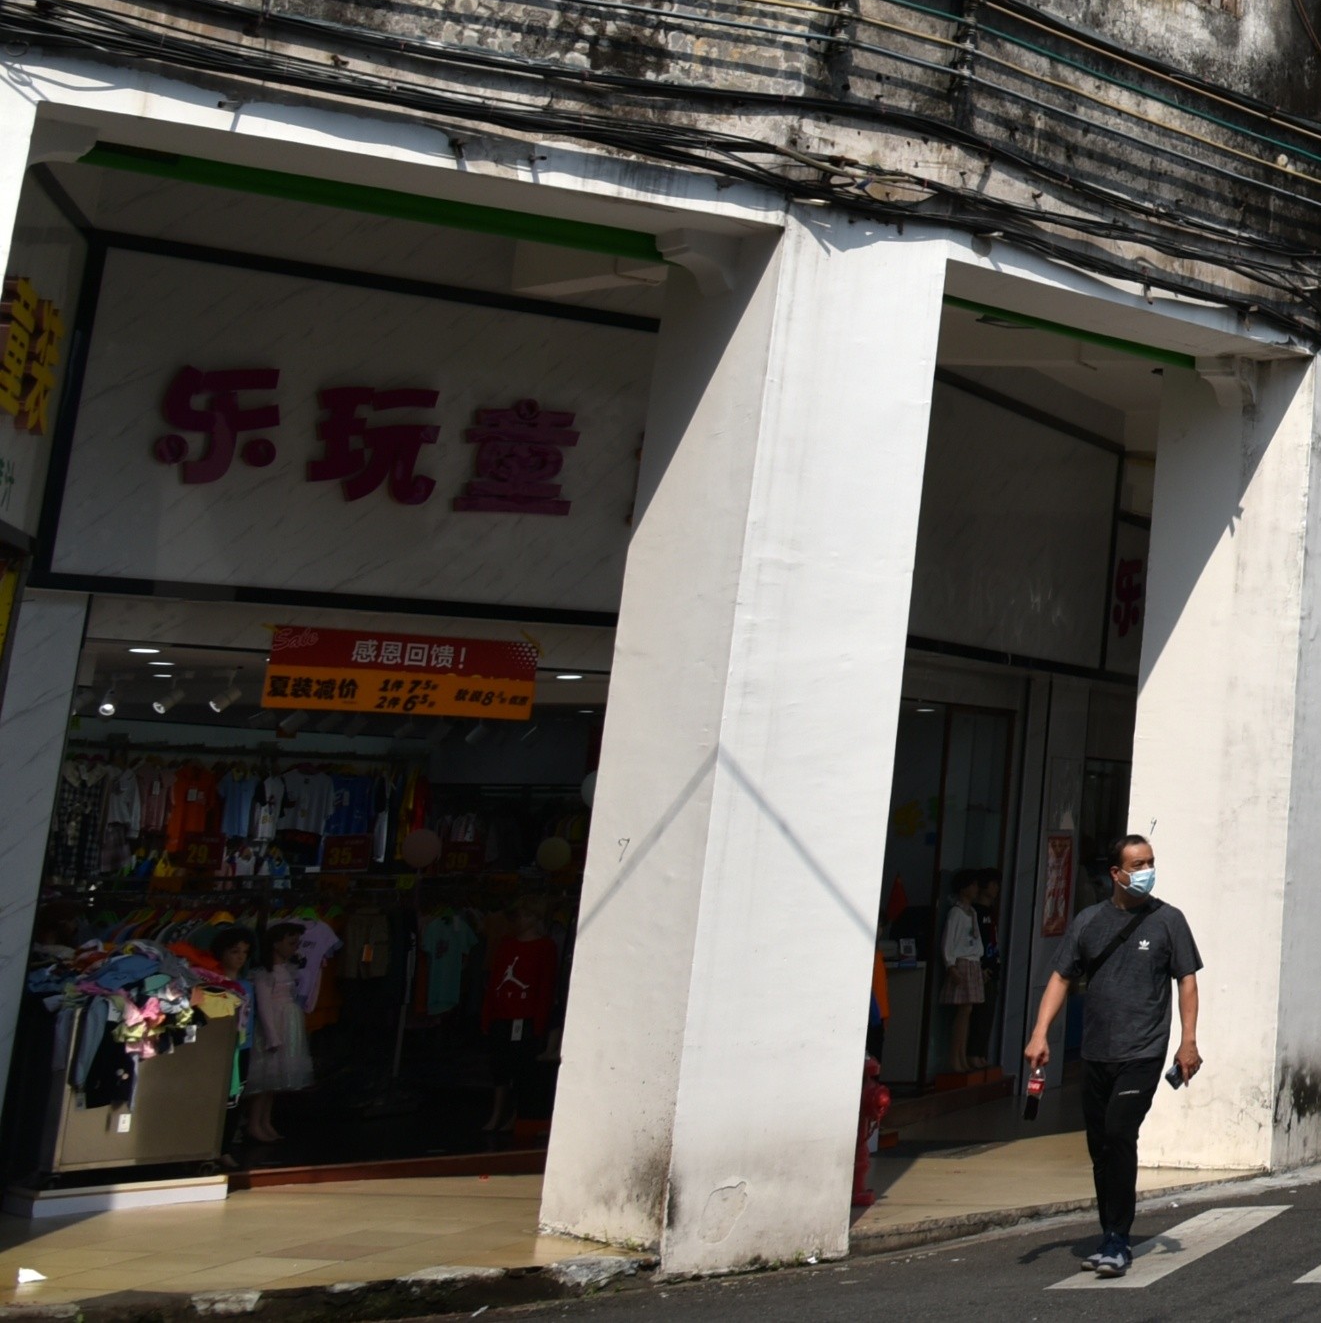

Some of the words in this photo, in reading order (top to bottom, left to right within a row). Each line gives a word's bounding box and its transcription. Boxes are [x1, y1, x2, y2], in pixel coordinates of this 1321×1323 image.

[154, 364, 581, 515] 乐玩童
[267, 676, 359, 700] 夏装减价
